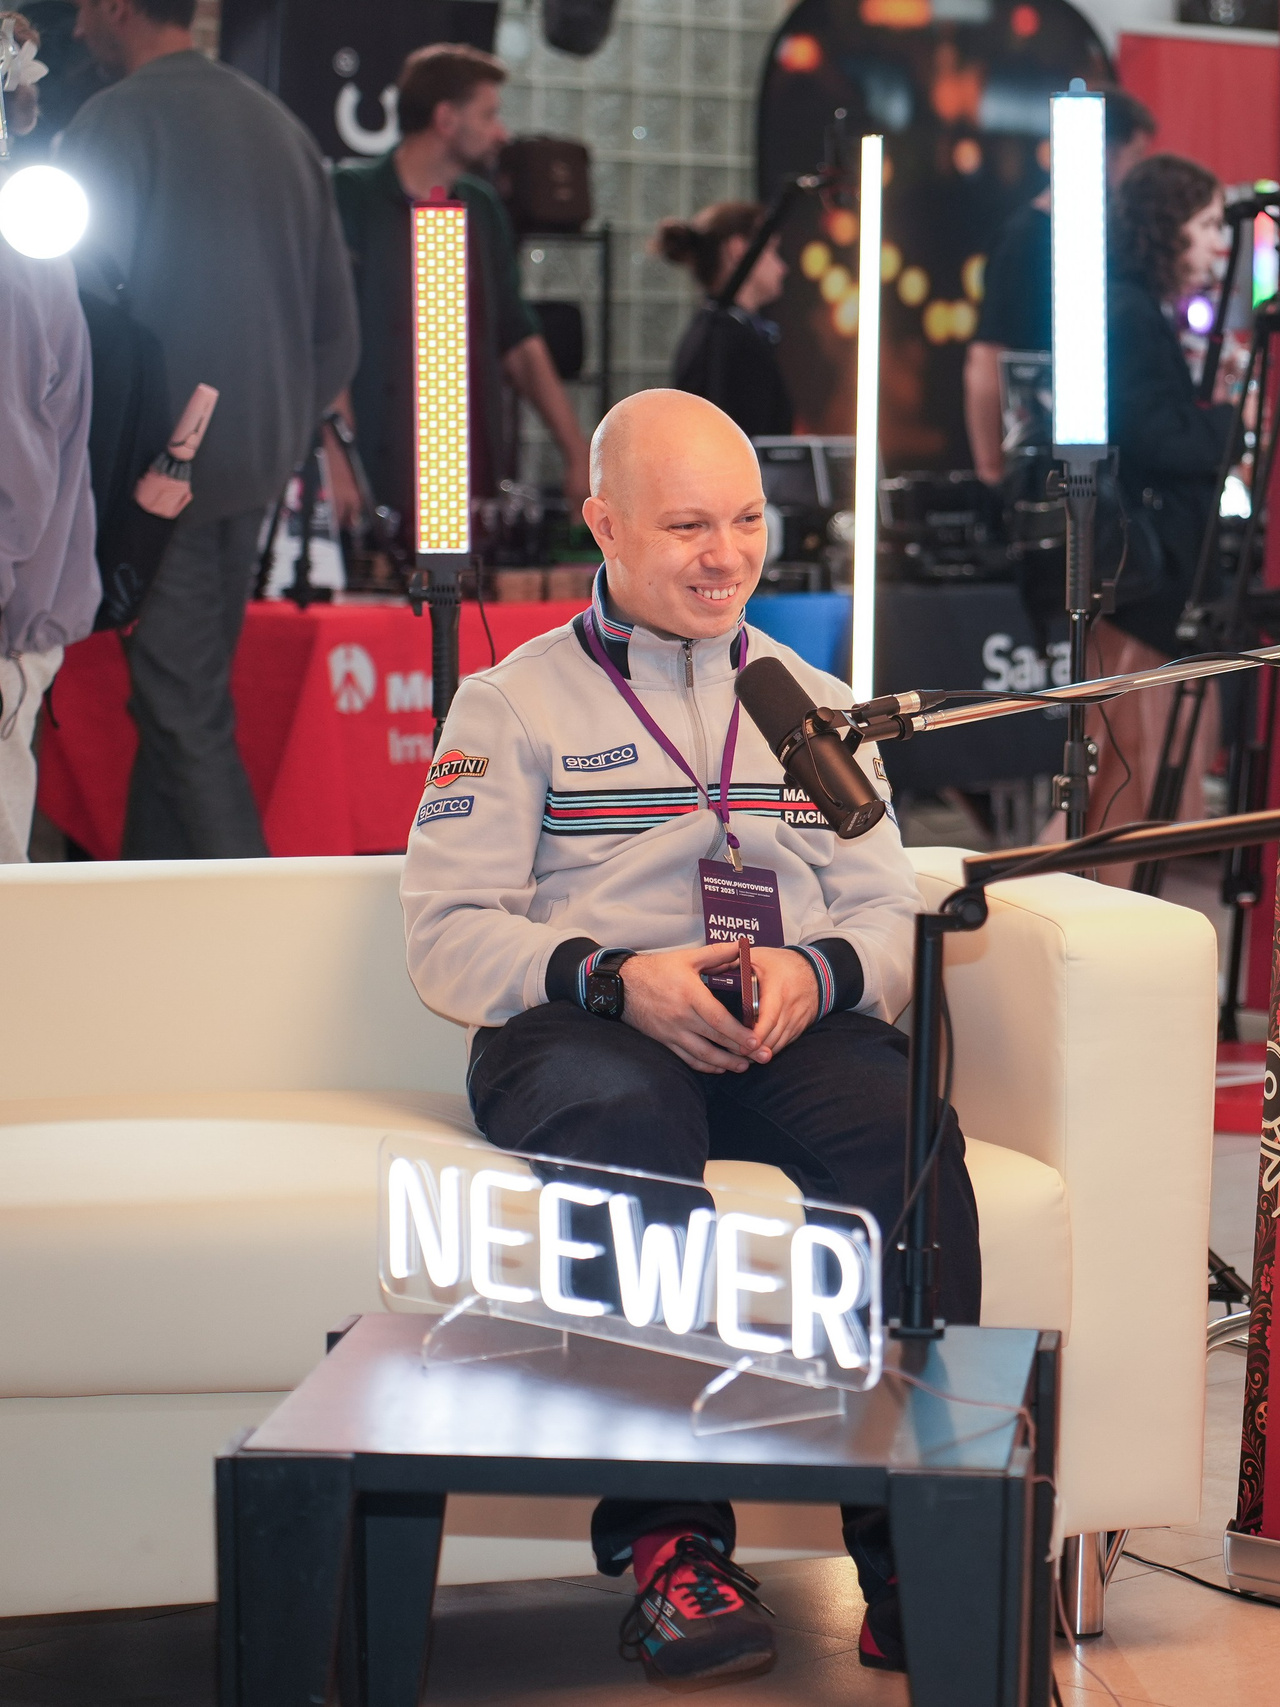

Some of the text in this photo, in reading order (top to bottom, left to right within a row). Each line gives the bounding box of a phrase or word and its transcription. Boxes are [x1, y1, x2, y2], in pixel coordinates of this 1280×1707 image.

[565, 746, 634, 770] sparco
[419, 798, 470, 820] sparco
[704, 884, 719, 893] FEST
[720, 886, 736, 895] 2025
[708, 913, 760, 932] АНДРЕЙ
[388, 1157, 868, 1370] NEEWER
